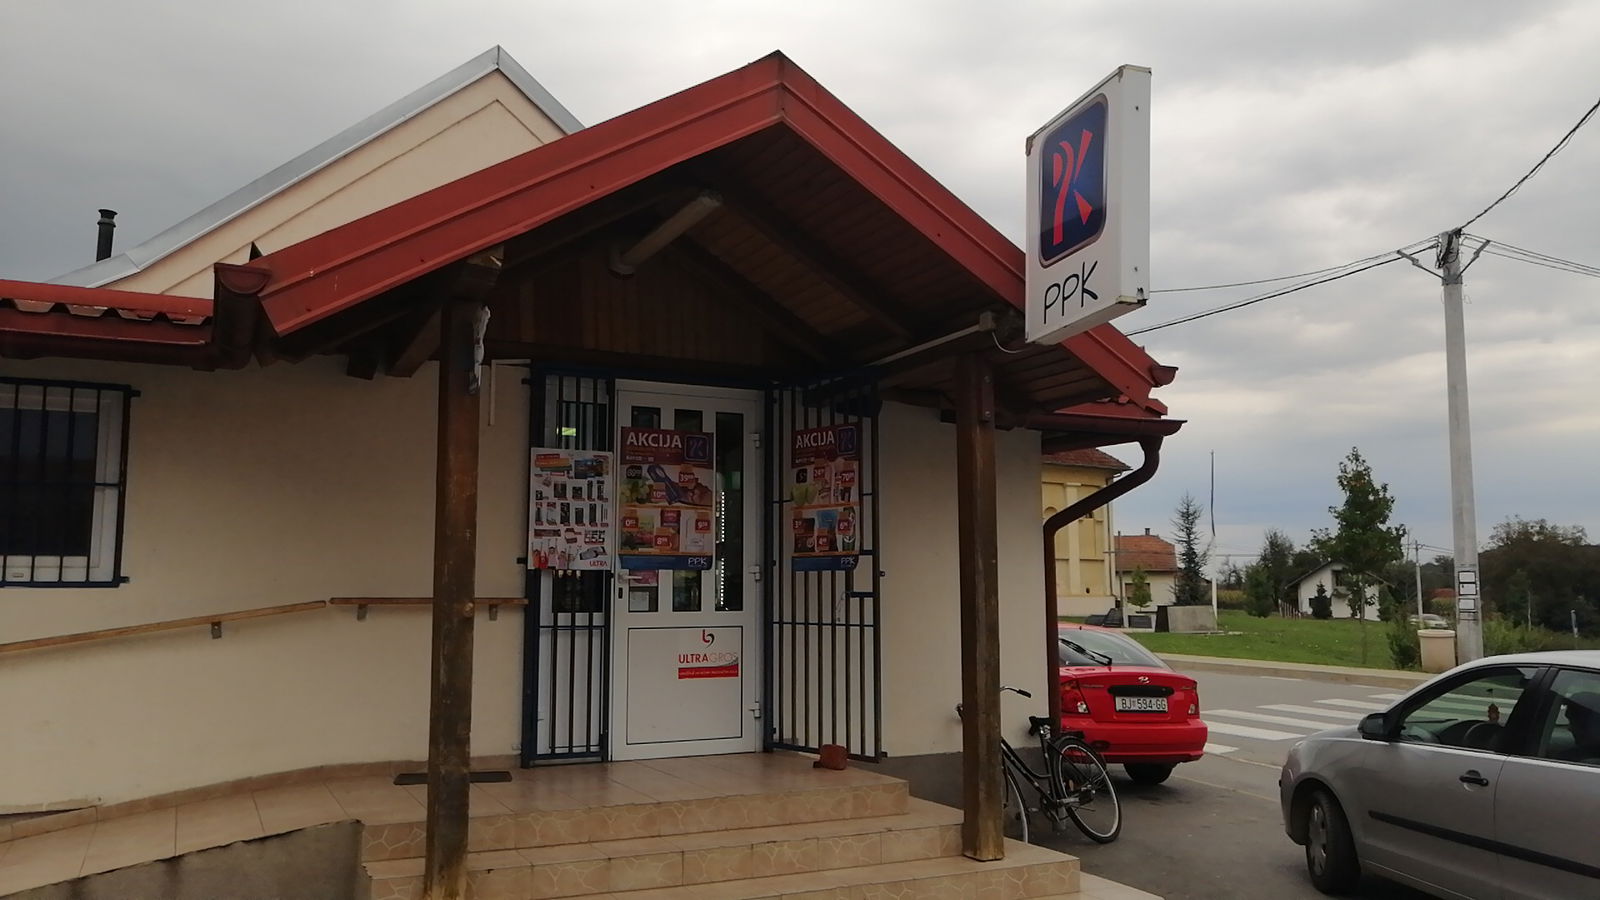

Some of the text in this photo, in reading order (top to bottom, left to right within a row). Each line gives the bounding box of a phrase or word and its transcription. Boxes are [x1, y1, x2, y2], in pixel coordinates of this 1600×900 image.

[1044, 260, 1099, 325] PPK
[626, 431, 682, 449] AKCIJA
[795, 430, 835, 449] AKCIJA
[688, 557, 707, 567] PPK
[1121, 698, 1167, 710] BJ 594-GG
